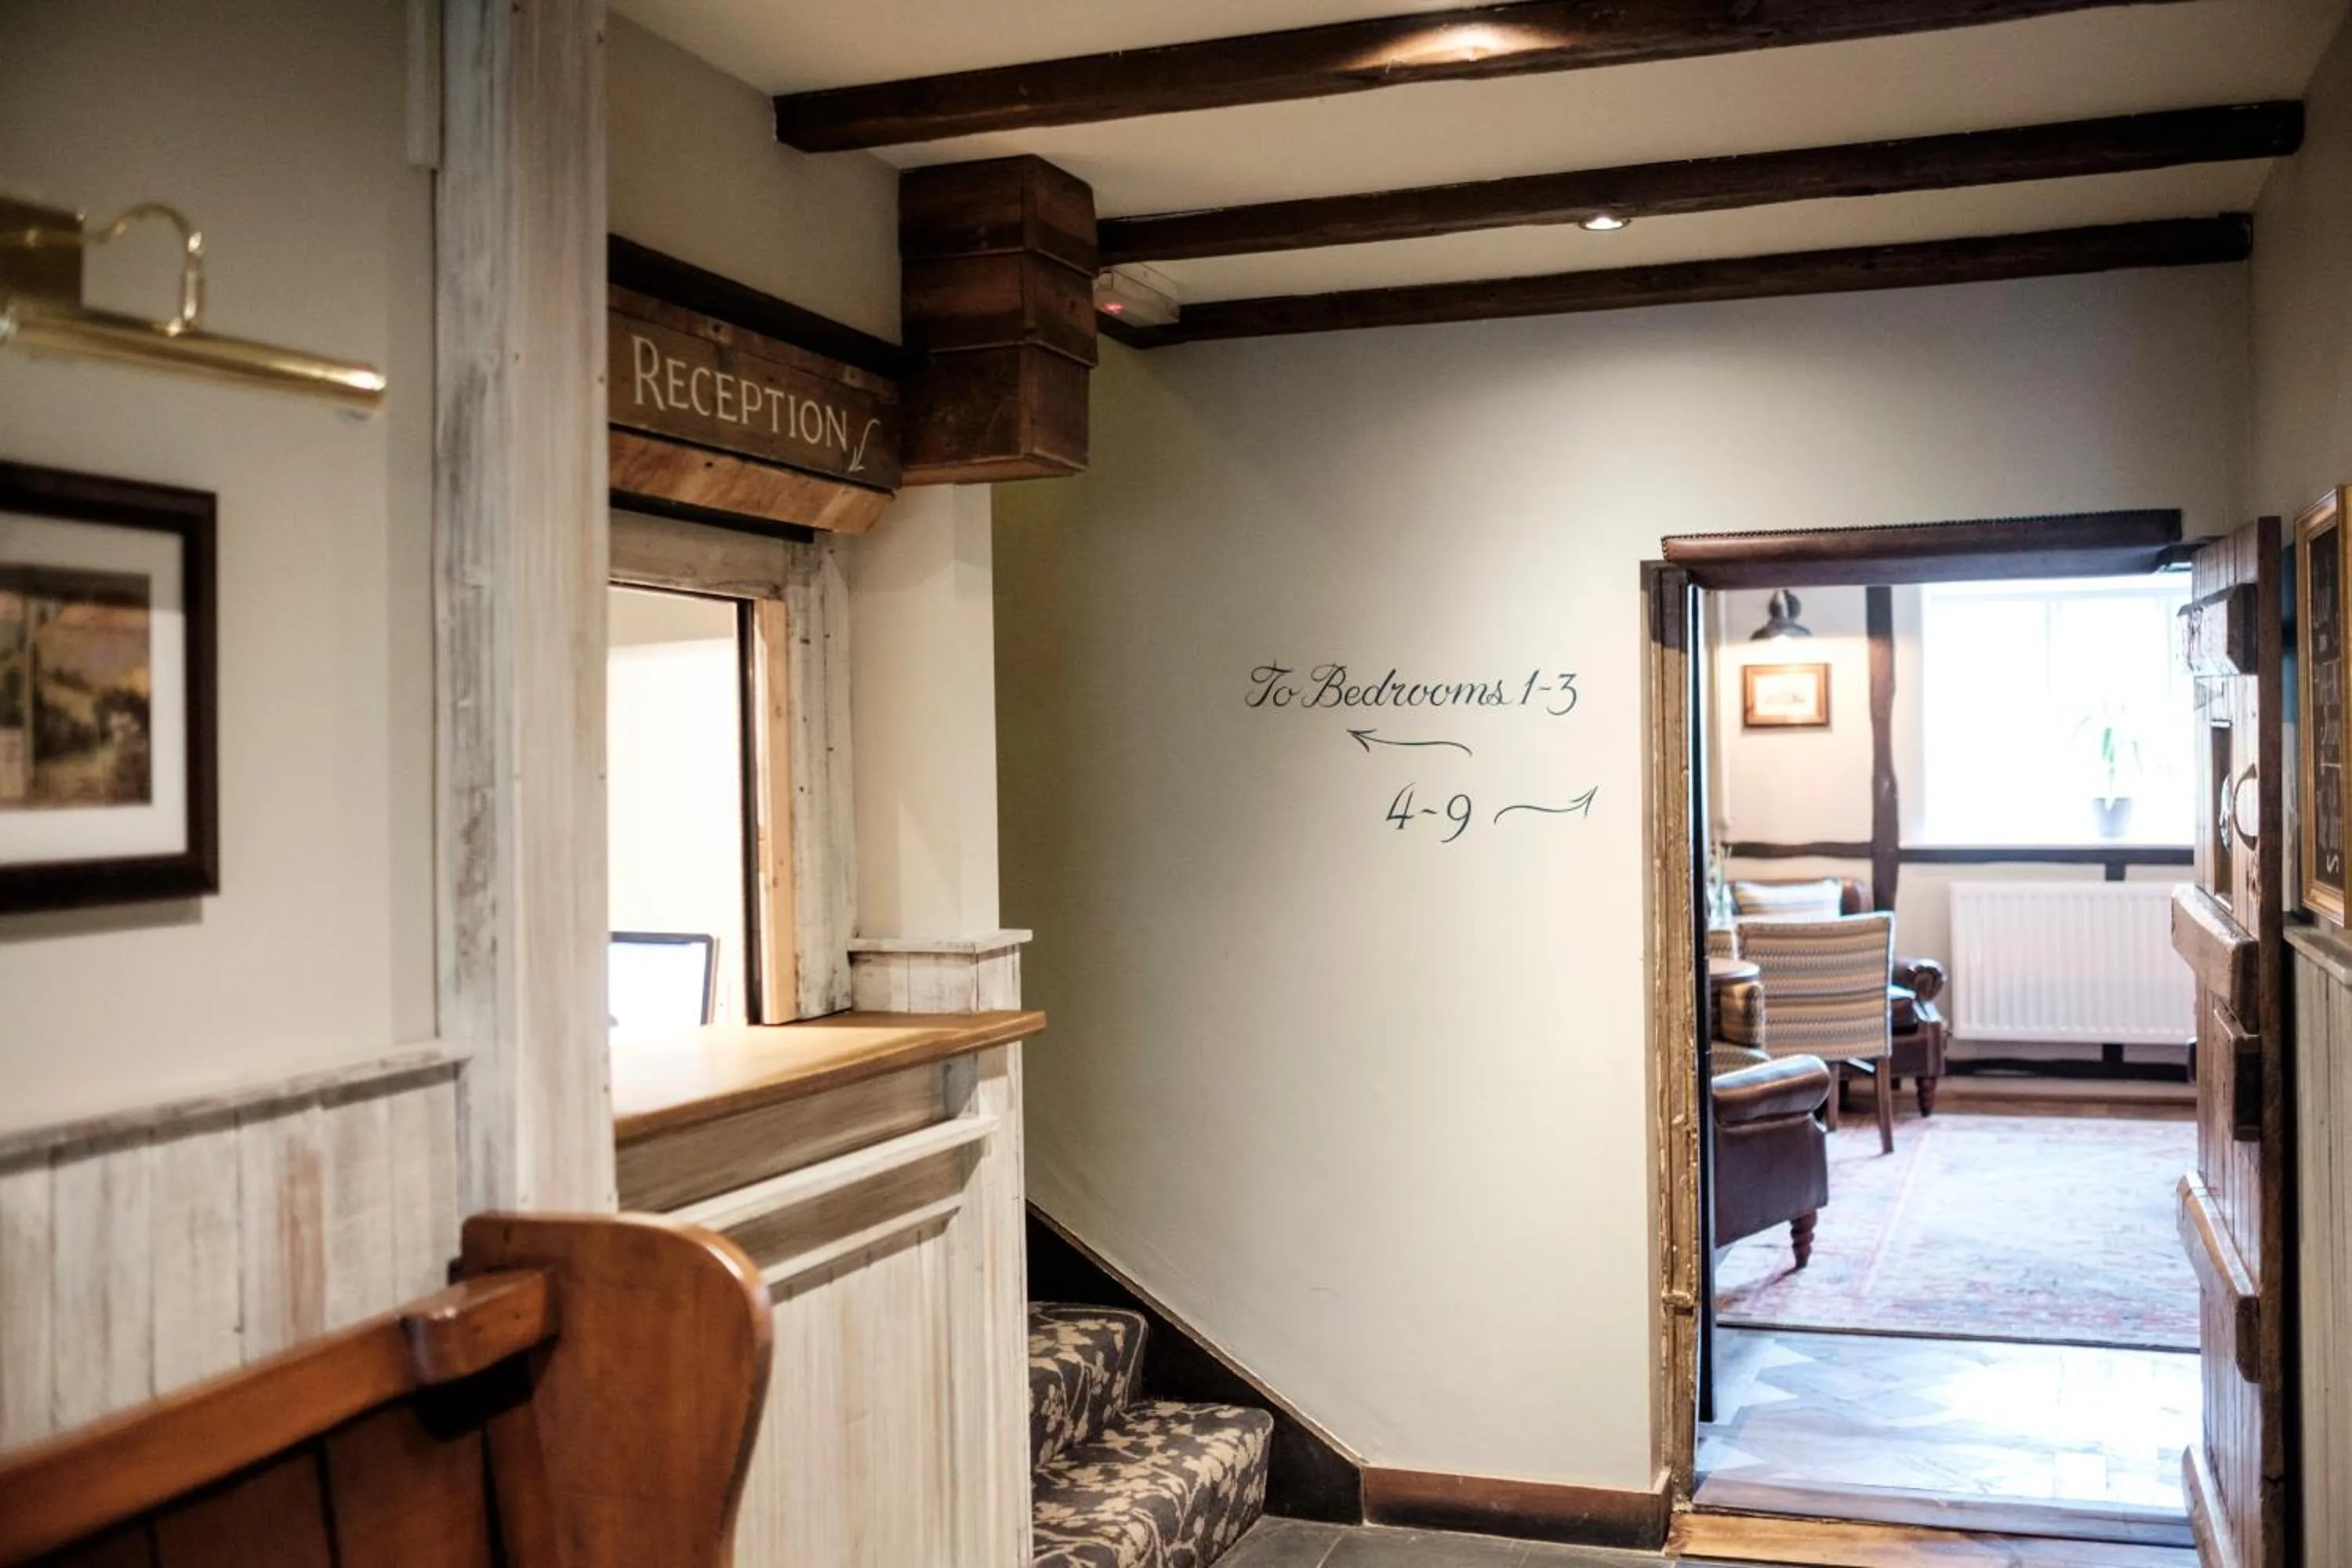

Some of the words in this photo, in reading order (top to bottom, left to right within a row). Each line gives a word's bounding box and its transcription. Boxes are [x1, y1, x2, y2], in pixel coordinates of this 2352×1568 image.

[632, 335, 848, 452] RECEPTION
[1245, 659, 1297, 709] To
[1301, 662, 1508, 709] Bedrooms
[1518, 668, 1578, 717] 1-3
[1385, 782, 1472, 843] 4-9
